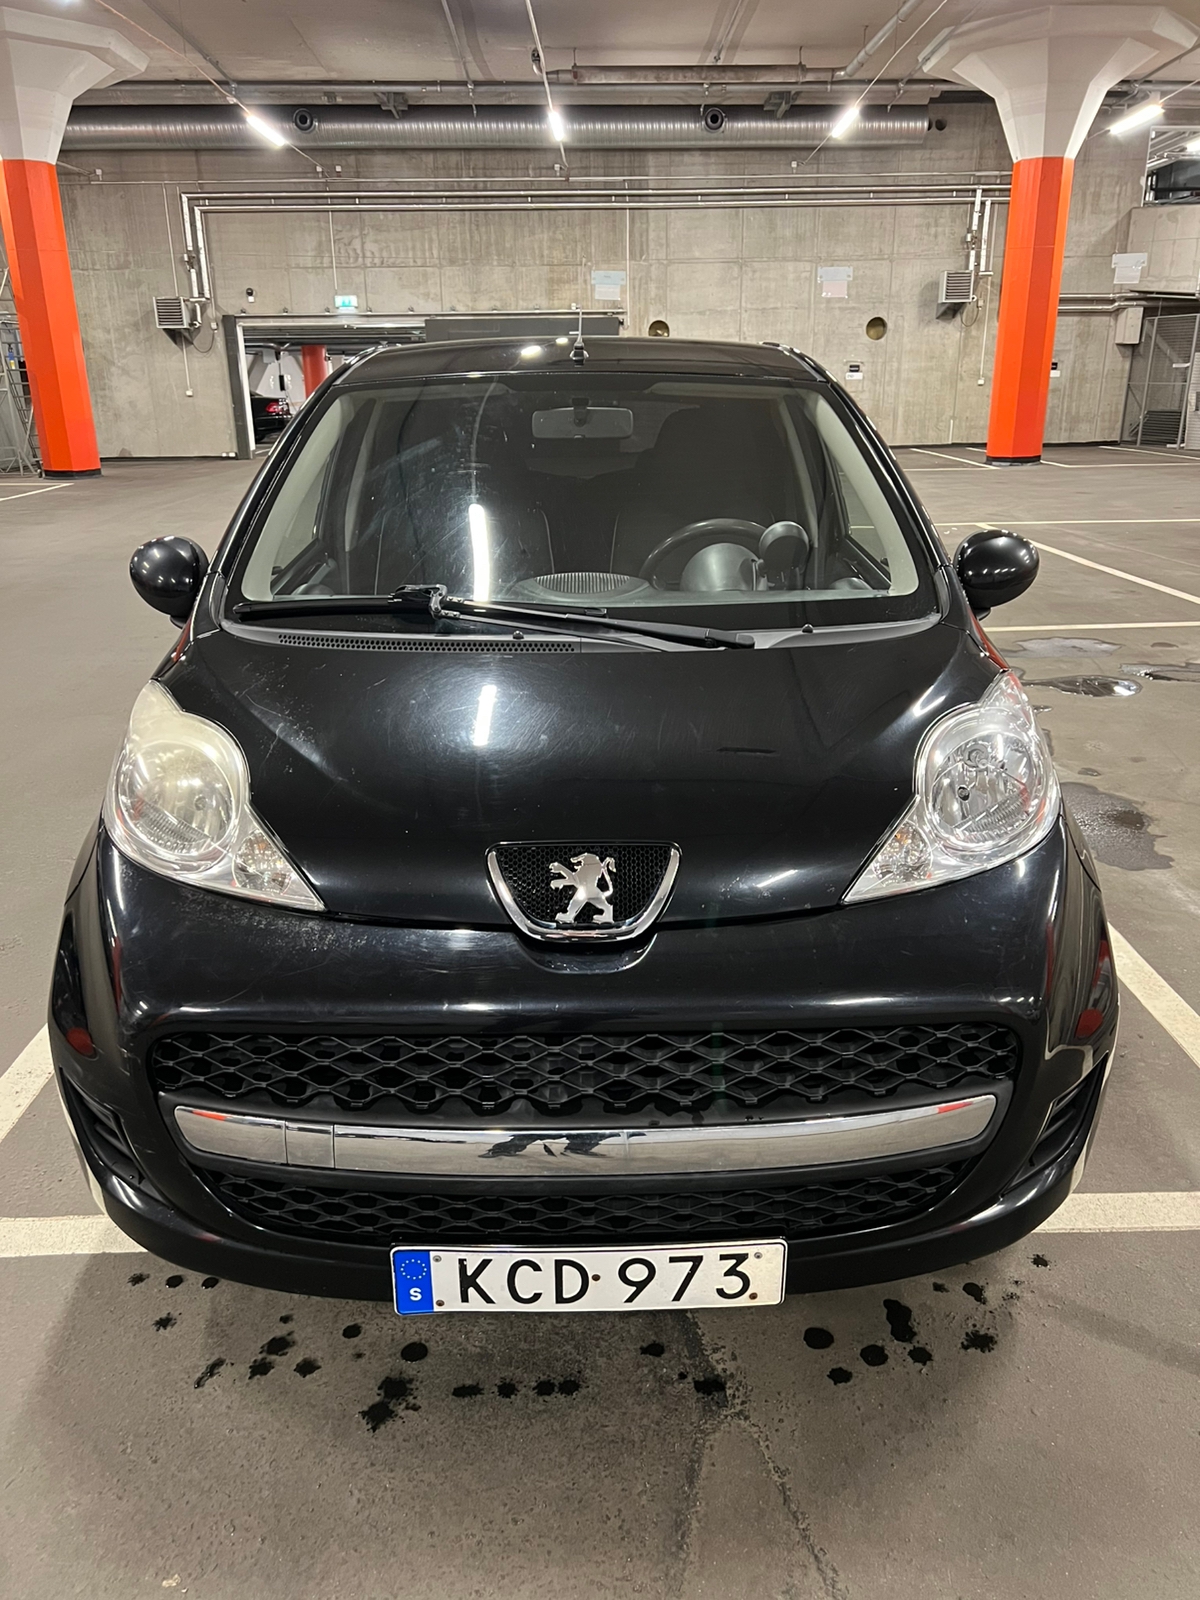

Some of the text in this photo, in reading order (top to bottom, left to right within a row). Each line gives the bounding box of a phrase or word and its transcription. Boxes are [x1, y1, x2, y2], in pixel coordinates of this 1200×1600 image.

[409, 1287, 422, 1301] S
[458, 1252, 751, 1305] KCD 973
